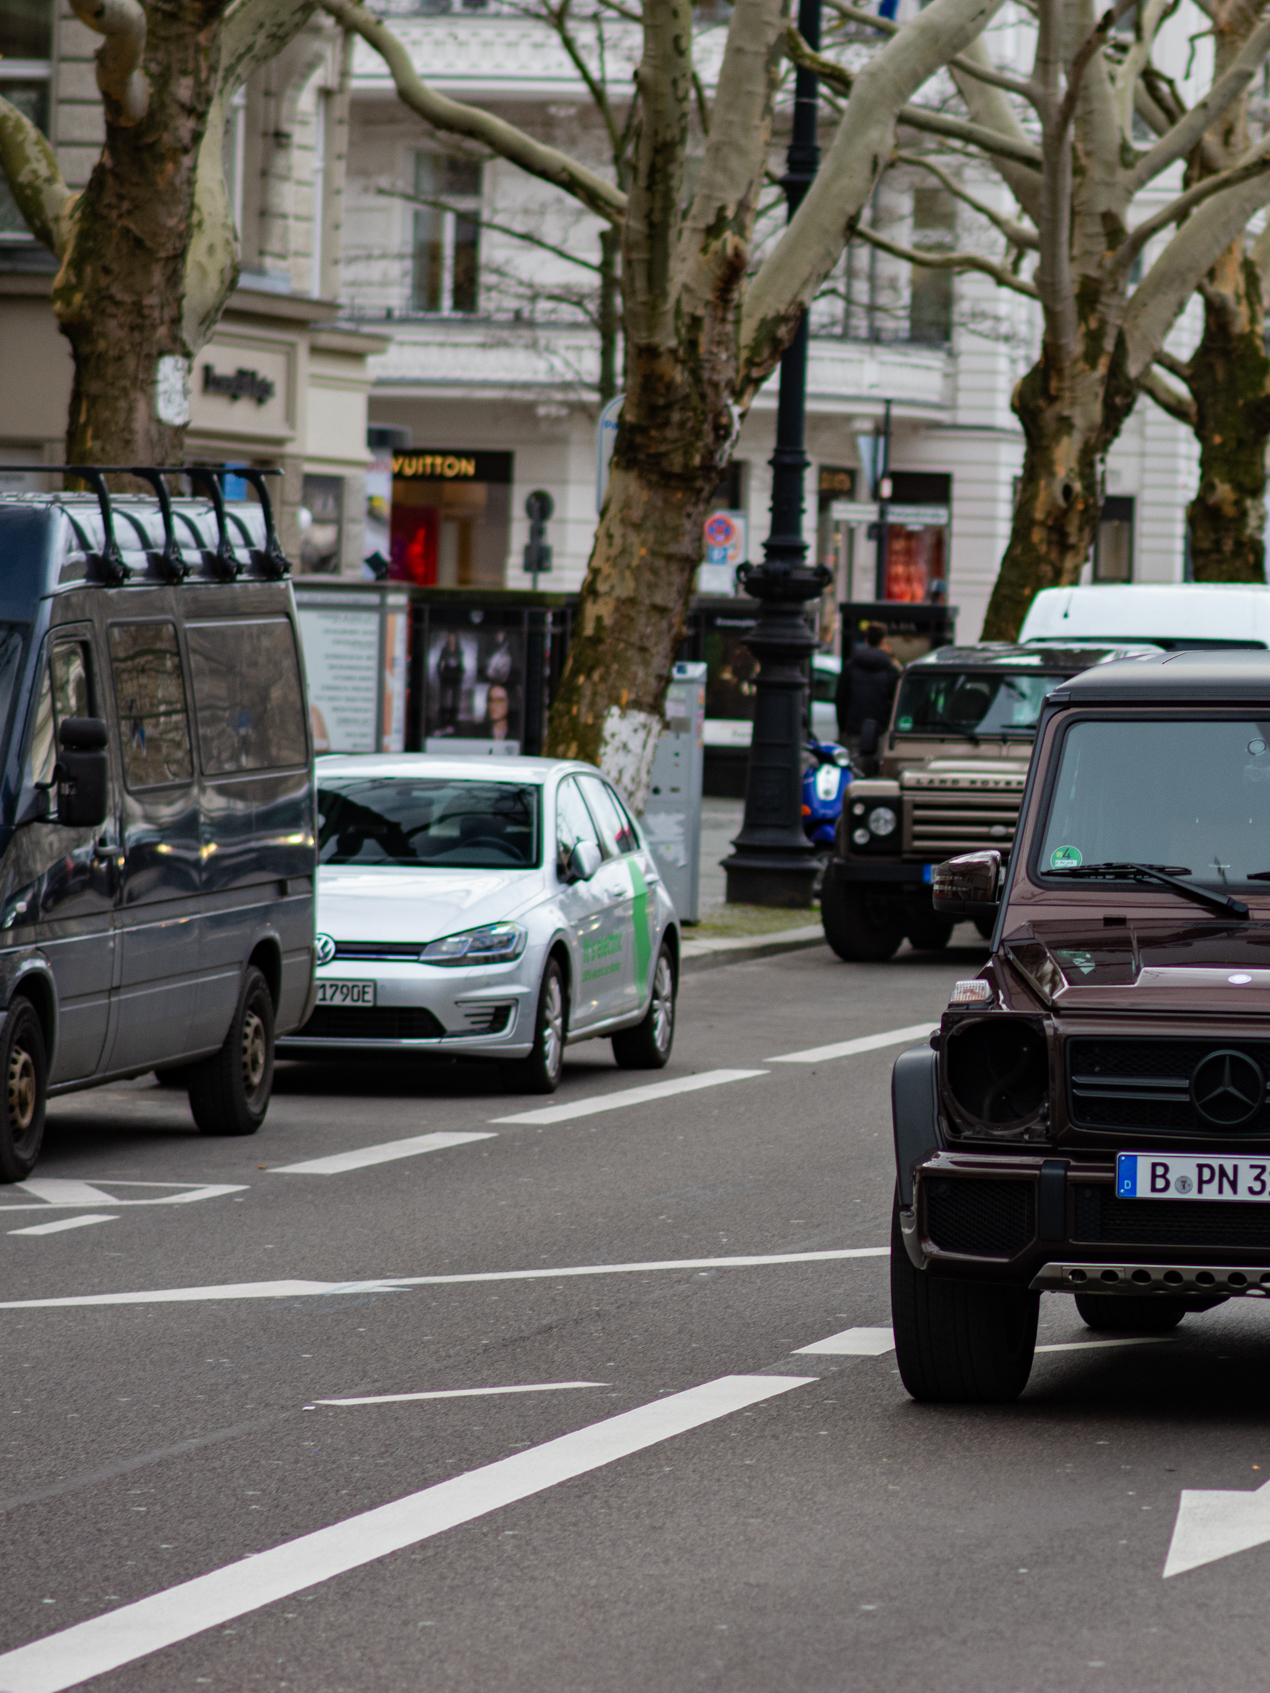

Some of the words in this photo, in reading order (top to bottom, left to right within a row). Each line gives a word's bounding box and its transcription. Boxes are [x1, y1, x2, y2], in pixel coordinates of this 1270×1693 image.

[392, 454, 476, 478] VUITTON
[916, 778, 960, 786] LAND
[969, 779, 1025, 787] ROVER
[1062, 847, 1072, 861] 4
[318, 983, 372, 1003] 1790E
[1124, 1180, 1132, 1190] D
[1150, 1161, 1171, 1193] B
[1196, 1163, 1239, 1195] PN
